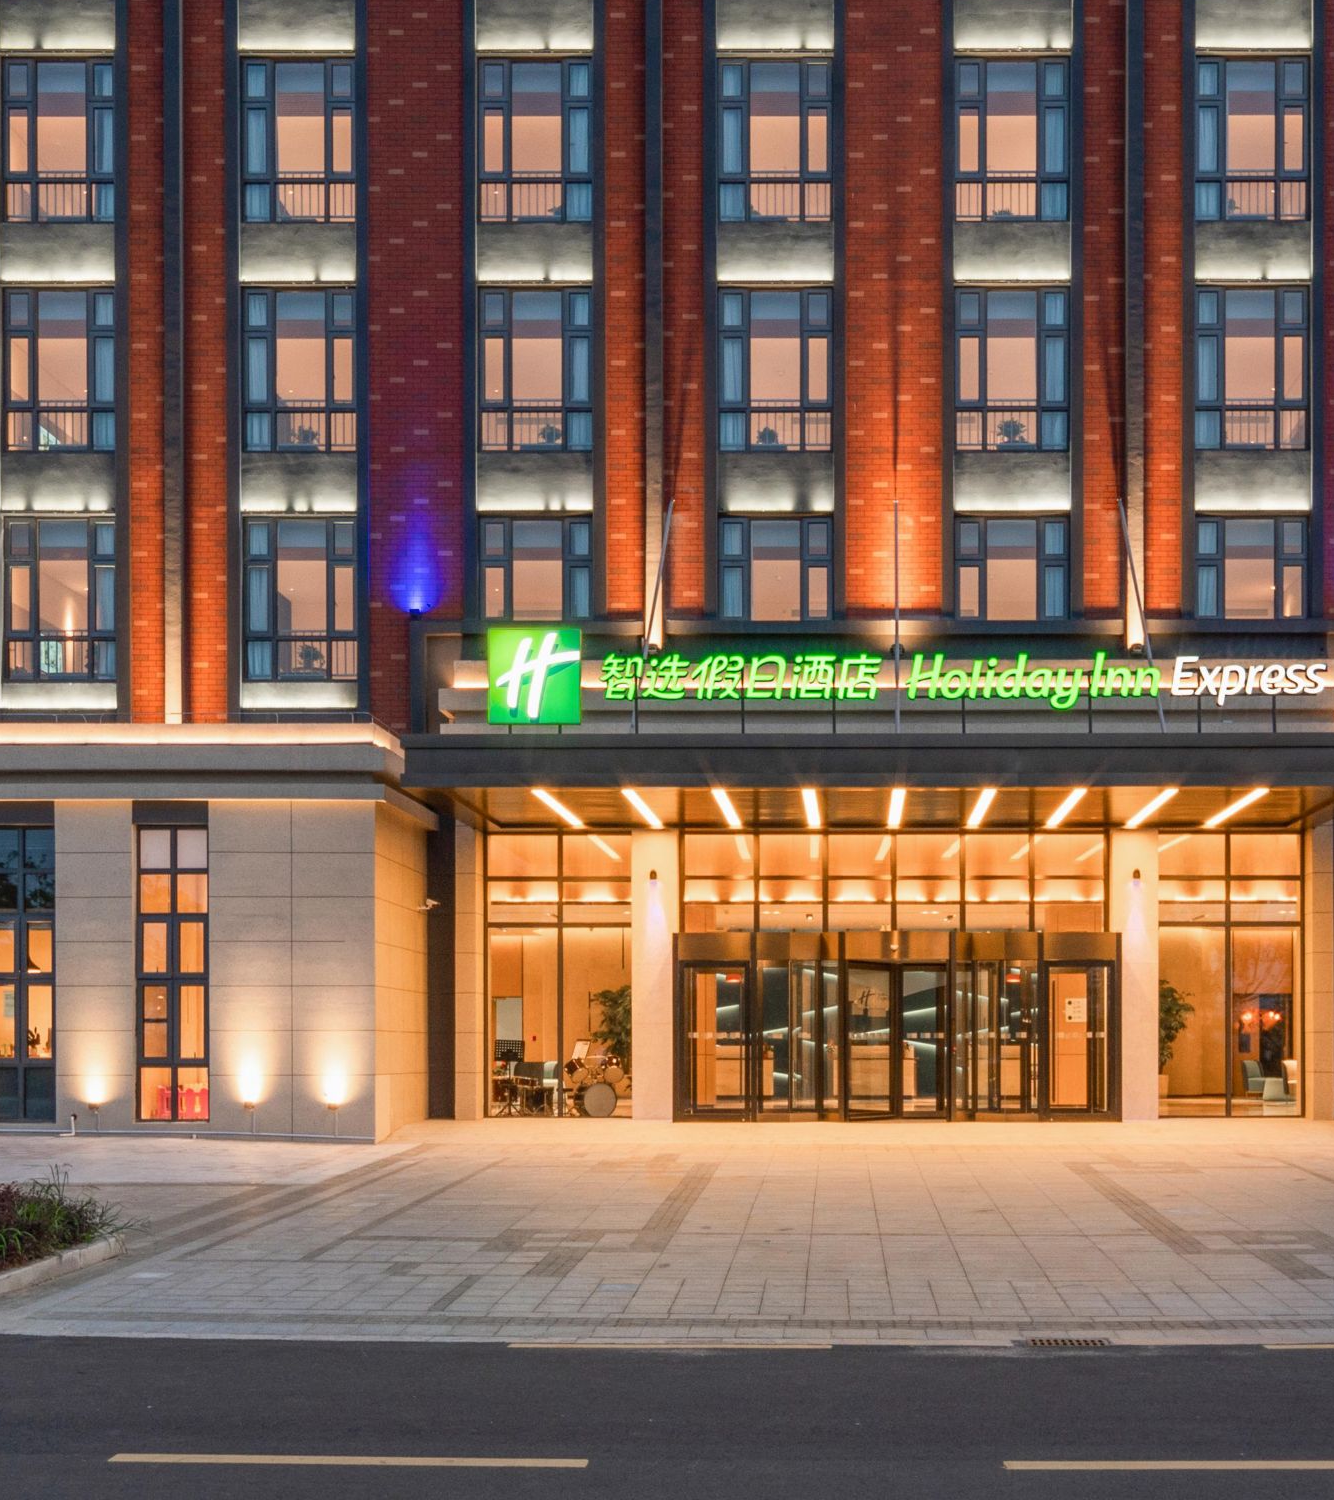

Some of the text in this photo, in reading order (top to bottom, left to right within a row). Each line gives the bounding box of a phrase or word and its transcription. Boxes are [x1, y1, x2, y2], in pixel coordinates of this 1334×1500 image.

[600, 652, 883, 701] 智选假日酒店
[905, 651, 1327, 710] Holiday Inn Express
